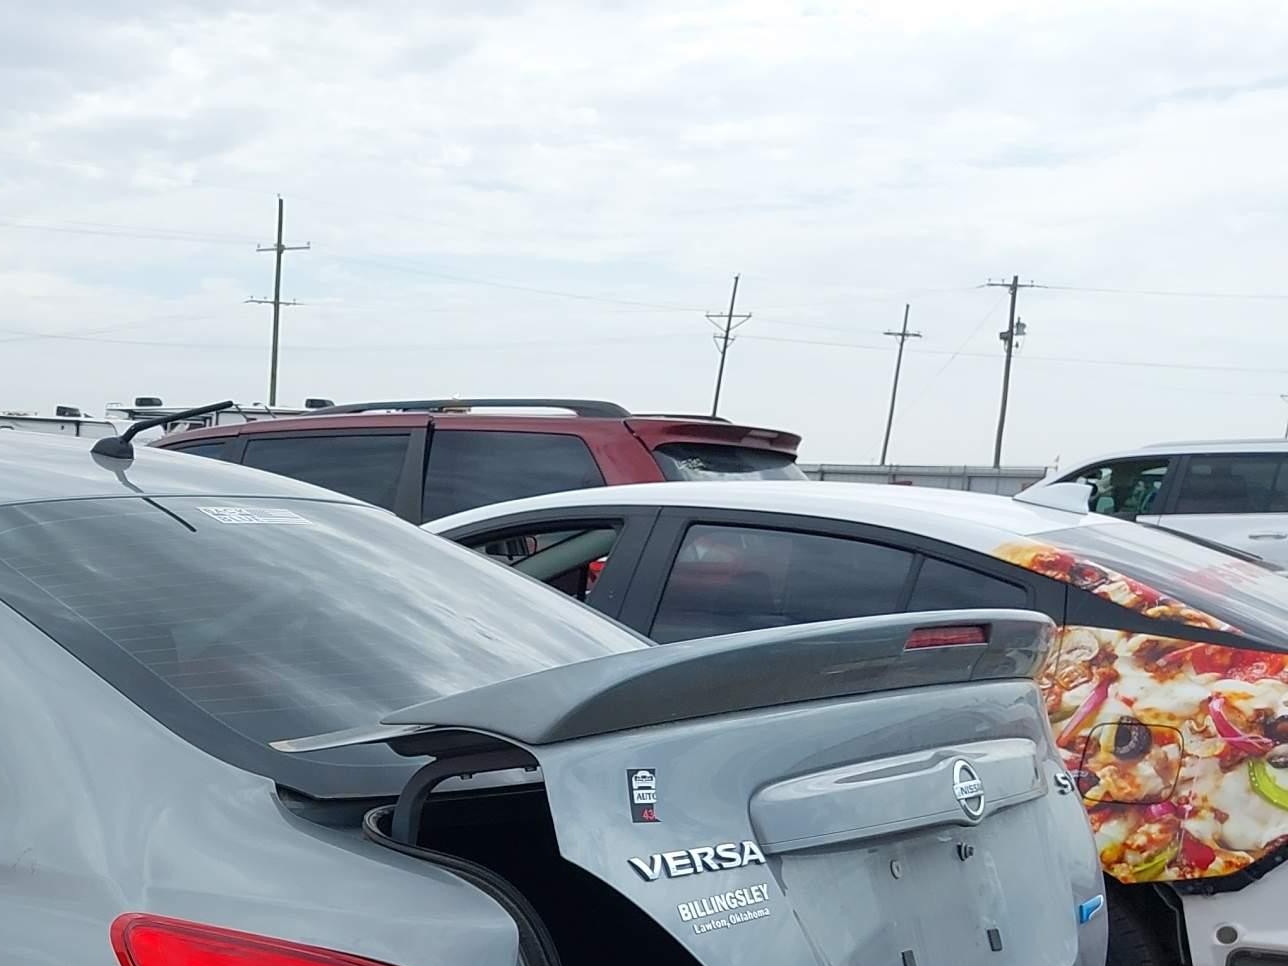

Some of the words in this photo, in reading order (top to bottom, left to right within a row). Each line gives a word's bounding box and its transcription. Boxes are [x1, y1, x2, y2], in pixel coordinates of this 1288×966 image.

[627, 840, 767, 882] VERSA
[677, 883, 770, 922] BILLINGSLEY
[729, 907, 770, 925] Oklahoma
